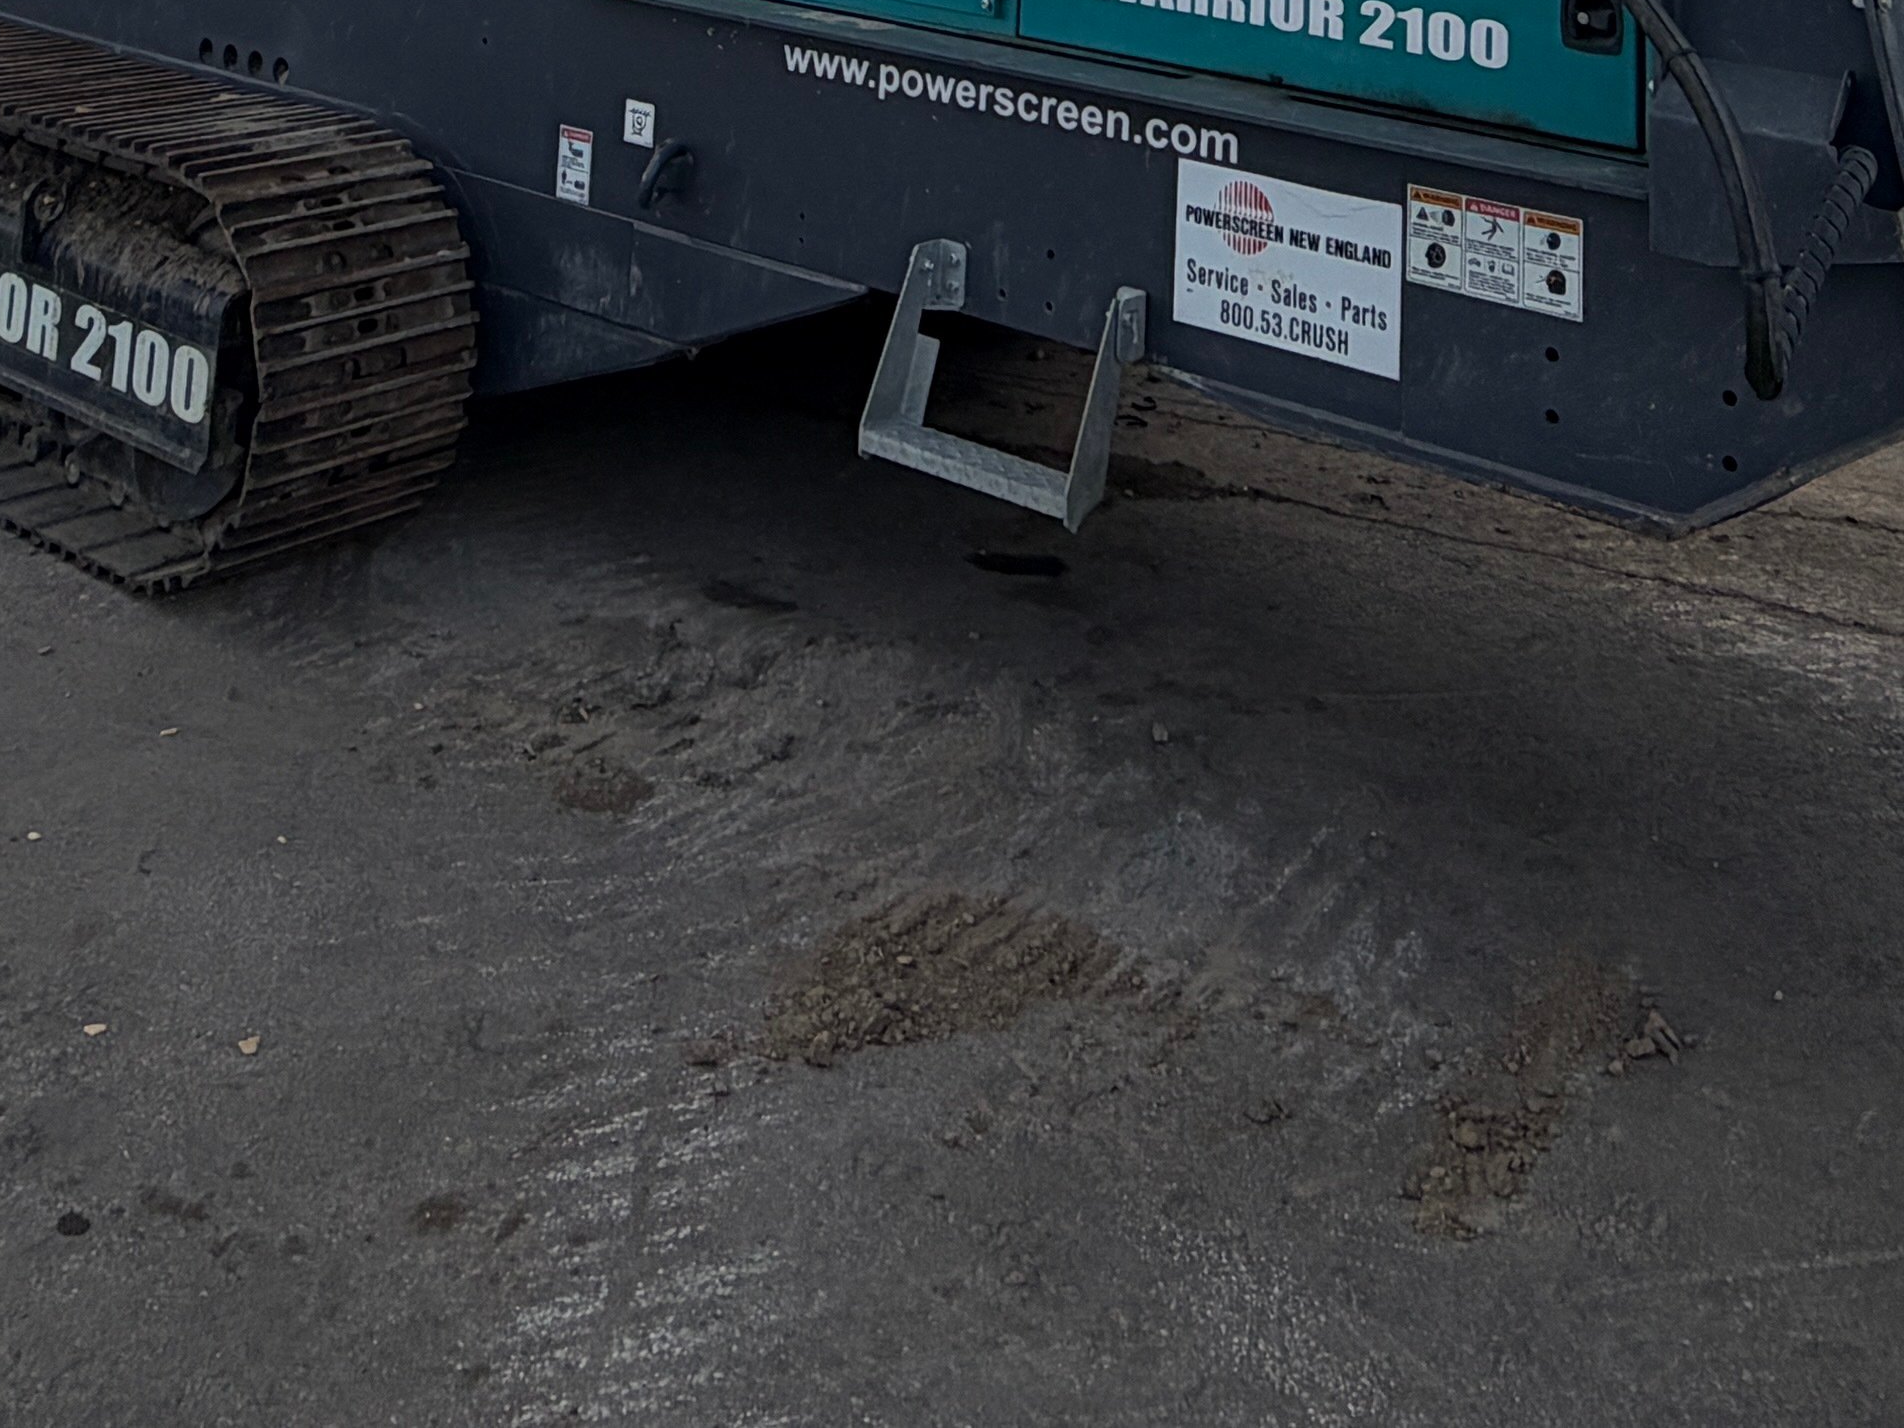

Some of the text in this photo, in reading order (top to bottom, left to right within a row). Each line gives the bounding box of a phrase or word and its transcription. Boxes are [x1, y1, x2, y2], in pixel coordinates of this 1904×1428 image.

[1359, 0, 1510, 69] 2100
[784, 44, 1239, 164] www.powerscreen.com
[1186, 205, 1391, 269] POWERSCREEN NEW ENGLAND
[1480, 203, 1517, 219] DANGER
[1187, 258, 1387, 331] Service Sales Parts
[1220, 299, 1349, 356] 800.53.CRUSH
[69, 303, 209, 424] 2100
